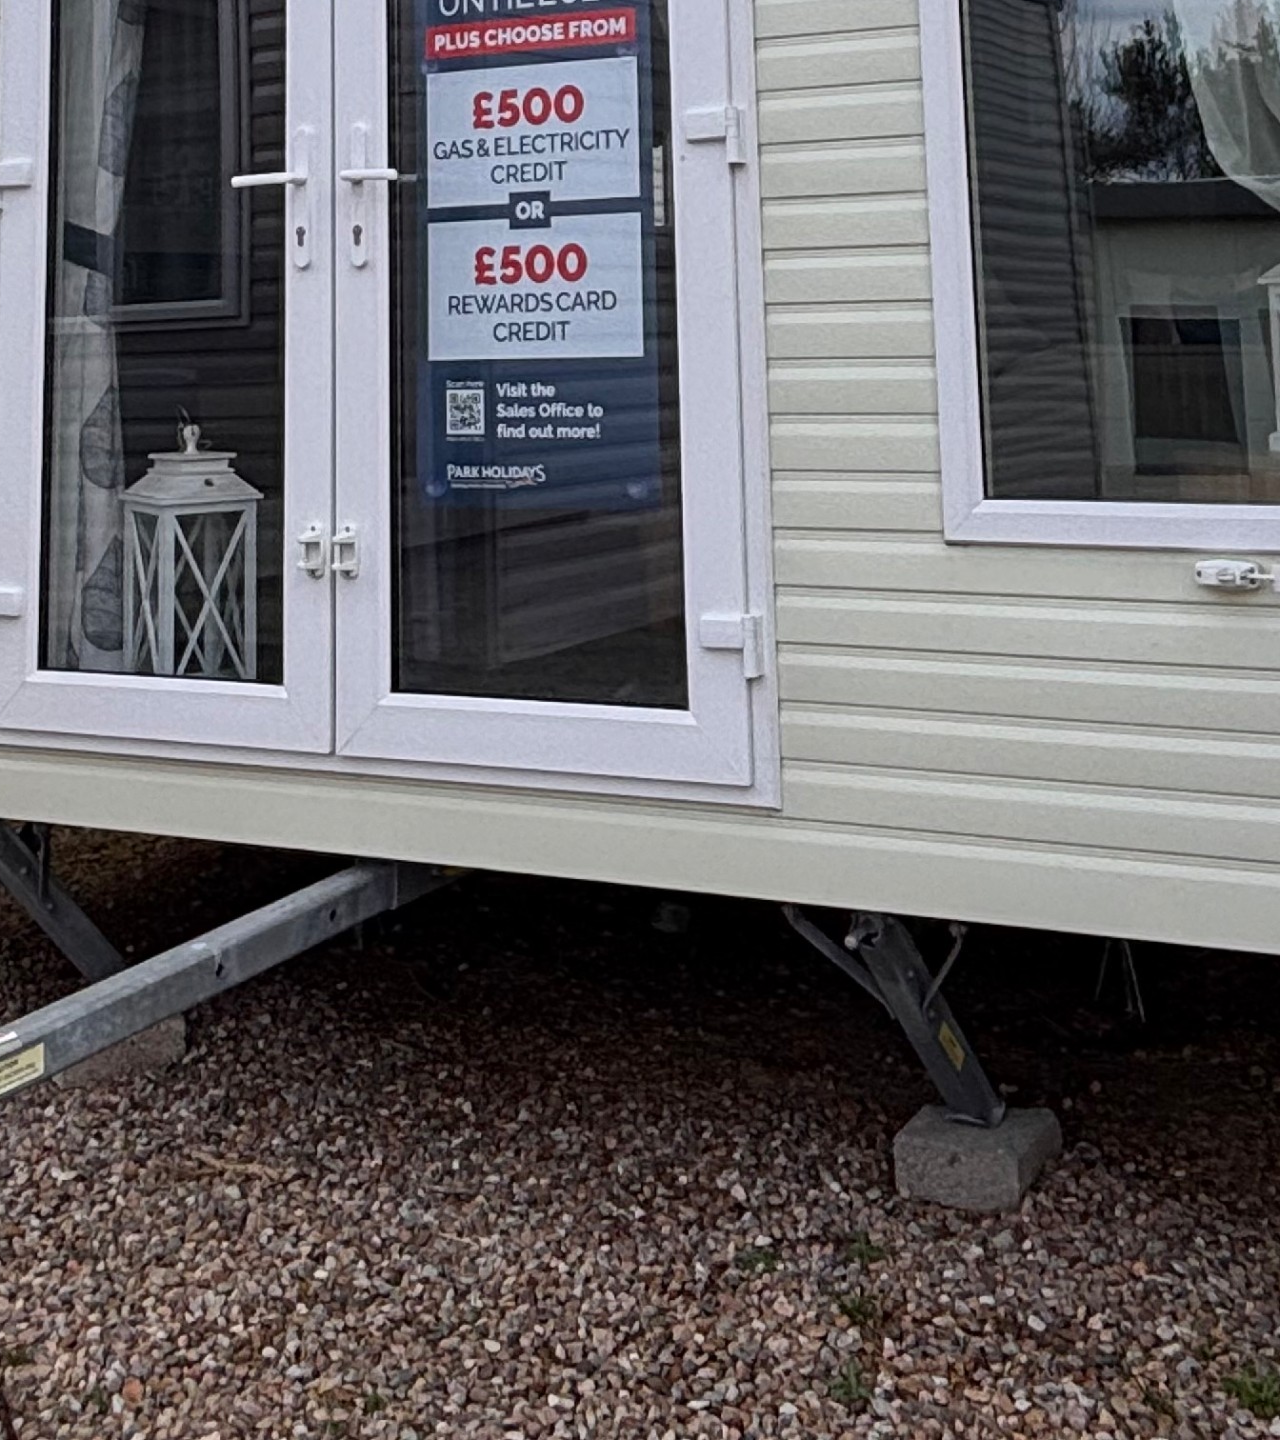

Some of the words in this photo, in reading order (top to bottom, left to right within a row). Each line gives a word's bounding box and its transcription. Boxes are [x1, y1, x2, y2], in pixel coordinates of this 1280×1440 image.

[434, 30, 480, 52] PLUS
[484, 21, 565, 46] CHOOSE
[569, 16, 627, 39] FROM
[472, 84, 585, 130] £500
[433, 138, 474, 160] GAS
[476, 137, 490, 158] &
[493, 128, 631, 157] ELECTRICITY
[490, 160, 568, 185] CREDIT
[515, 200, 545, 220] OR
[474, 242, 589, 286] £500
[447, 291, 553, 315] REWARDS
[556, 290, 618, 312] CARD
[493, 320, 571, 342] CREDIT
[496, 382, 528, 398] Visit
[530, 382, 556, 398] the
[496, 402, 536, 418] Sales
[538, 402, 584, 419] Office
[587, 403, 604, 418] to
[496, 423, 526, 439] find
[528, 424, 554, 439] out
[556, 423, 601, 439] more!
[447, 464, 480, 481] PARK
[481, 464, 547, 482] HOLIDAYS
